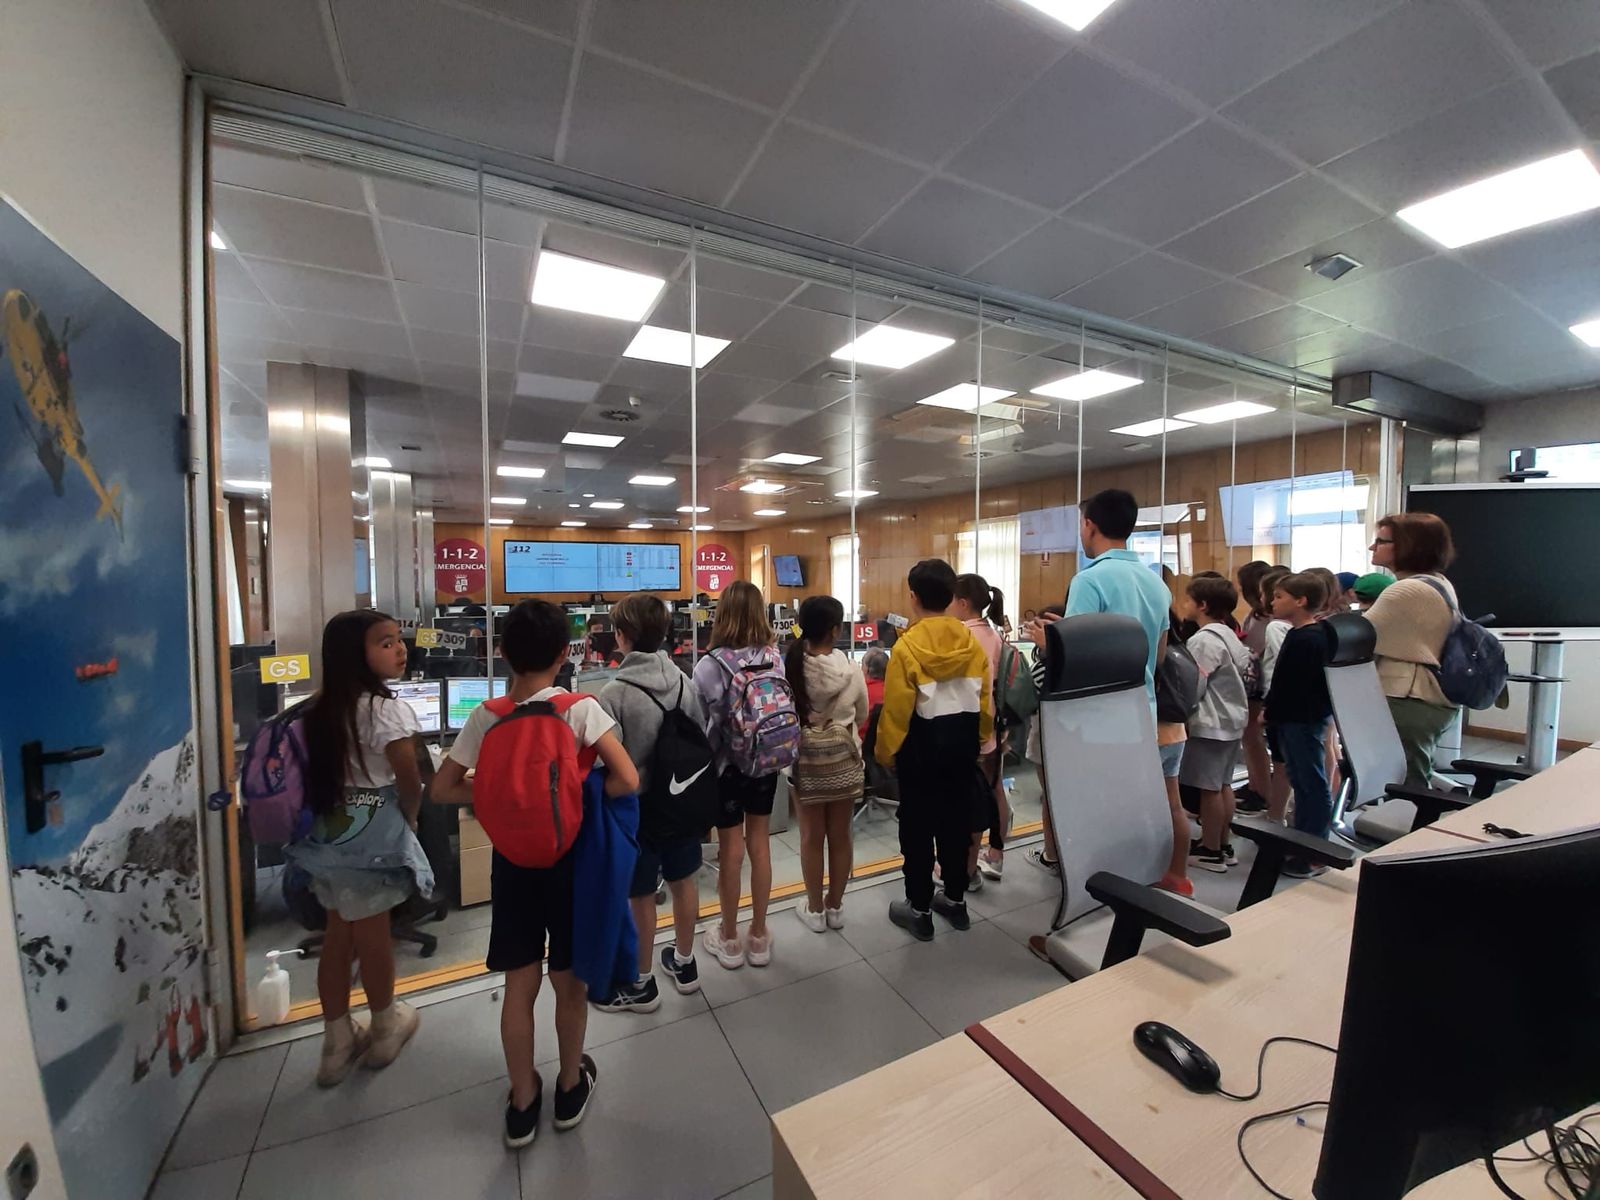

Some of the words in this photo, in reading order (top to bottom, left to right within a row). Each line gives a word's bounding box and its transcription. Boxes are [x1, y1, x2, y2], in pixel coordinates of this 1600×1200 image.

[442, 548, 479, 560] 1-1-2
[511, 545, 531, 553] 112
[701, 552, 727, 562] 1-1-2
[398, 619, 414, 629] 314
[857, 626, 874, 638] JS
[436, 633, 466, 645] 7309
[568, 642, 585, 657] 7306
[269, 659, 301, 678] GS
